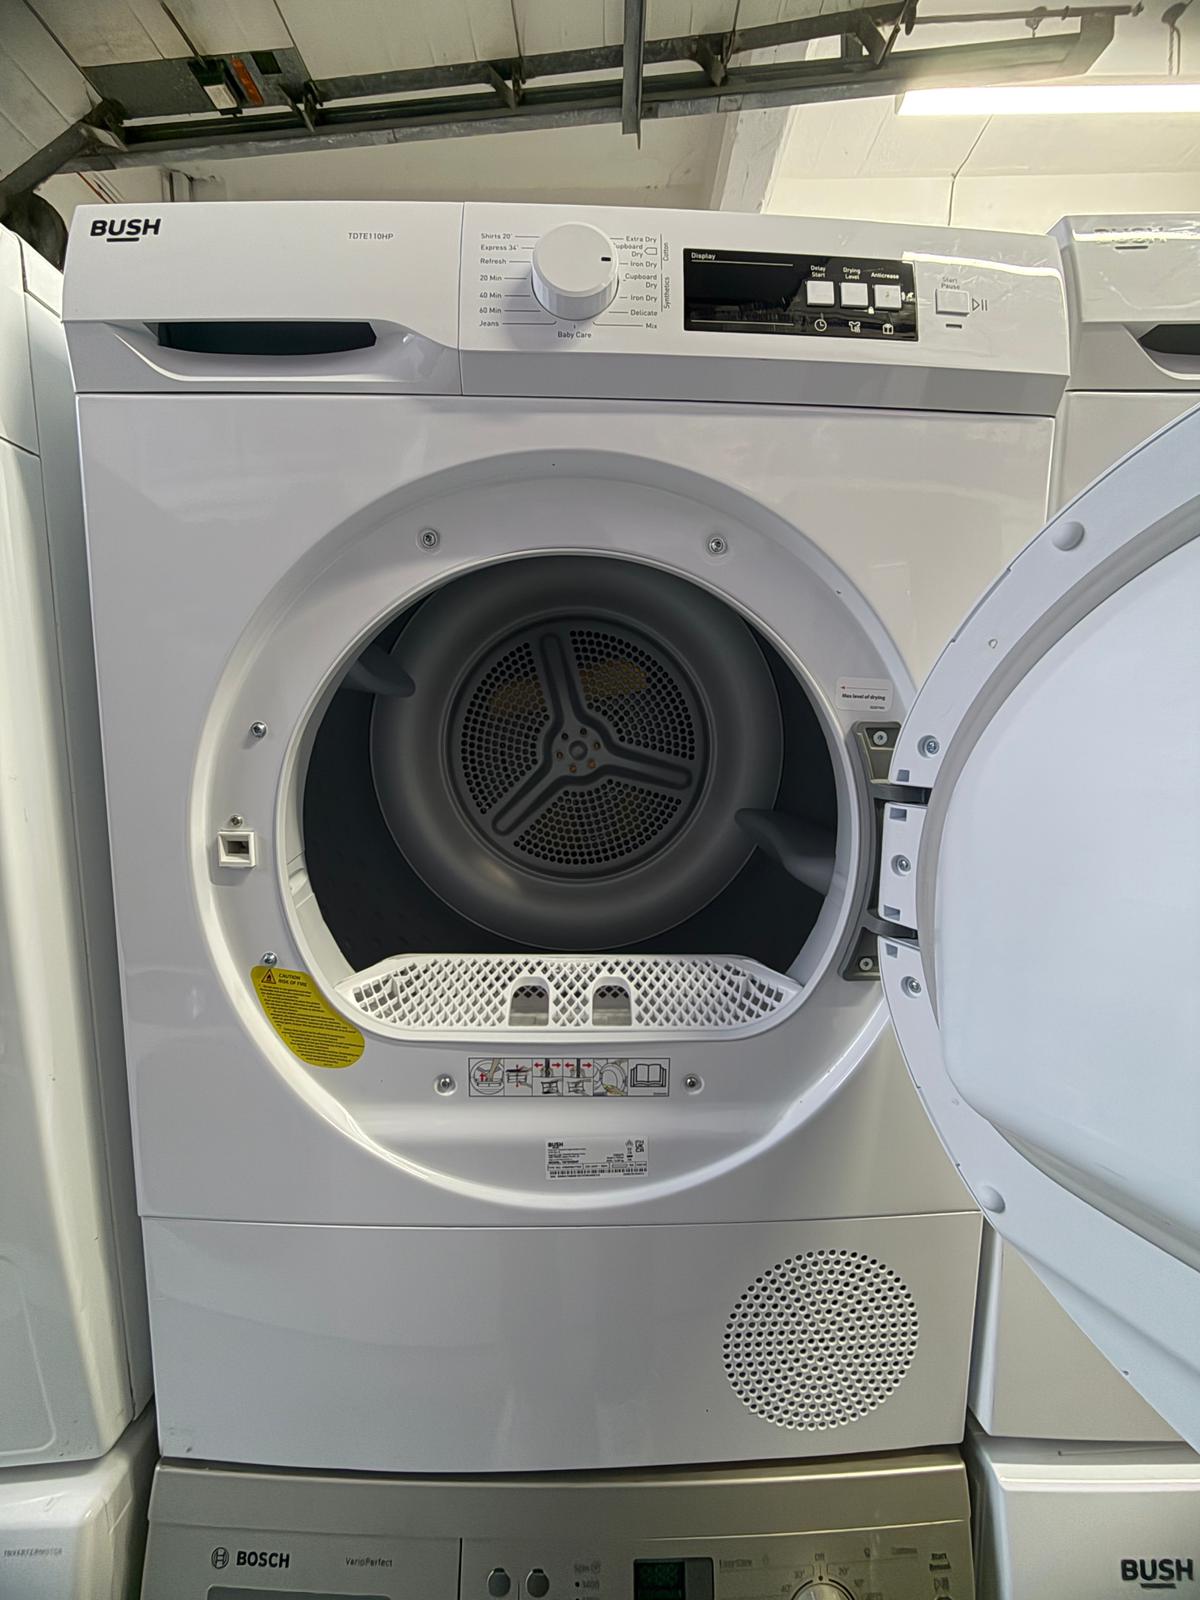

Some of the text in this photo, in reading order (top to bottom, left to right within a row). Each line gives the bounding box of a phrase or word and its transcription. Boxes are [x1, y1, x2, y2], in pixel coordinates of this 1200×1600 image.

[90, 218, 162, 237] BUSH
[348, 232, 394, 240] TDTE110HP
[480, 244, 506, 252] Express
[691, 252, 716, 260] Display
[842, 267, 861, 275] Drying
[625, 273, 657, 281] Cupboard
[236, 1550, 290, 1568] BOSCH
[345, 1557, 393, 1568] VarioPerfect
[1121, 1558, 1194, 1581] BUSH
